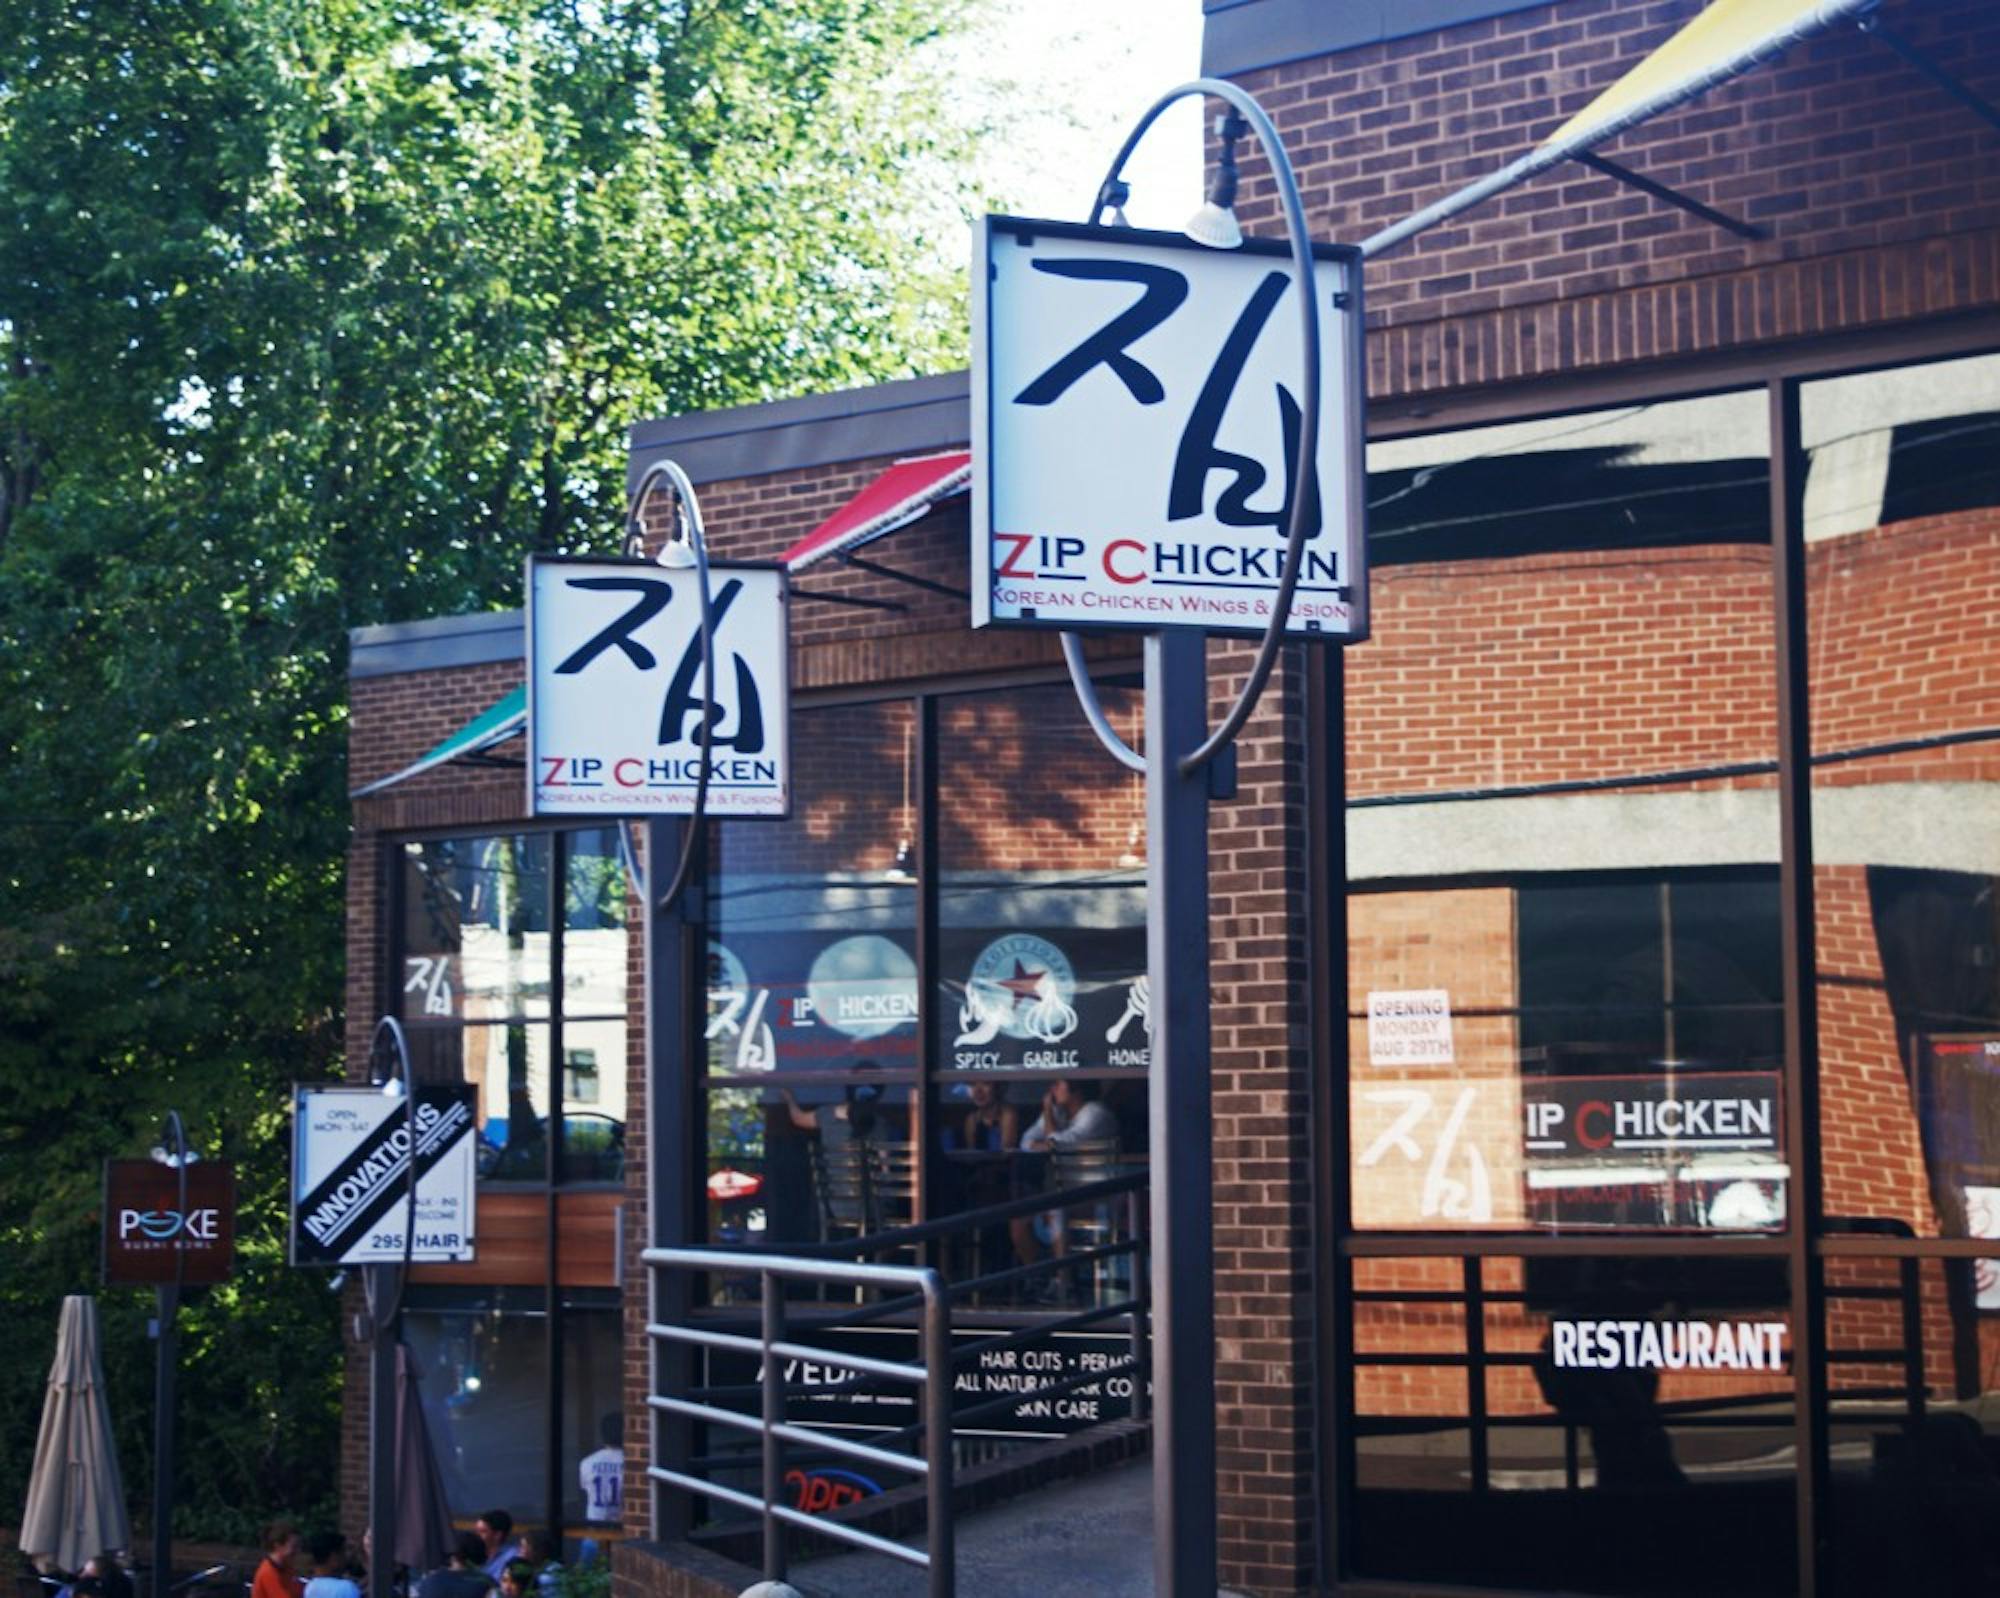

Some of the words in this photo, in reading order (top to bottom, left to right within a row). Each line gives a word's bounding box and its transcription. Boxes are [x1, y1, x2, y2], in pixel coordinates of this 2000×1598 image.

[994, 532, 1086, 580] ZIP
[1102, 538, 1339, 585] CHICKEN
[992, 587, 1076, 607] KOREAN
[1081, 591, 1173, 611] CHICKEN
[1179, 596, 1249, 615] WINGS
[1253, 601, 1270, 616] &
[1287, 602, 1349, 619] USION
[542, 756, 603, 787] ZIP
[613, 757, 776, 788] CHICKEN
[666, 793, 713, 805] WINS
[777, 996, 815, 1028] ZIP
[1374, 999, 1443, 1017] OPENING
[1375, 1019, 1440, 1036] MONDAY
[1107, 1049, 1150, 1067] HONE
[1374, 1041, 1404, 1056] AUG
[1409, 1039, 1451, 1055] 29TH
[954, 1051, 1000, 1069] SPICY
[1022, 1050, 1080, 1068] GARLIC
[1526, 1101, 1567, 1139] IP
[1574, 1098, 1771, 1151] CHICKEN
[303, 1102, 441, 1237] INNOVATIONS
[372, 1235, 403, 1249] 295
[415, 1234, 460, 1248] HAIR
[1552, 1320, 1788, 1371] RESTAURANT
[980, 1350, 1018, 1369] HAIR
[1022, 1351, 1063, 1371] CUTS
[954, 1373, 982, 1392] ALL
[1055, 1399, 1100, 1420] CARE
[592, 1475, 620, 1508] 11
